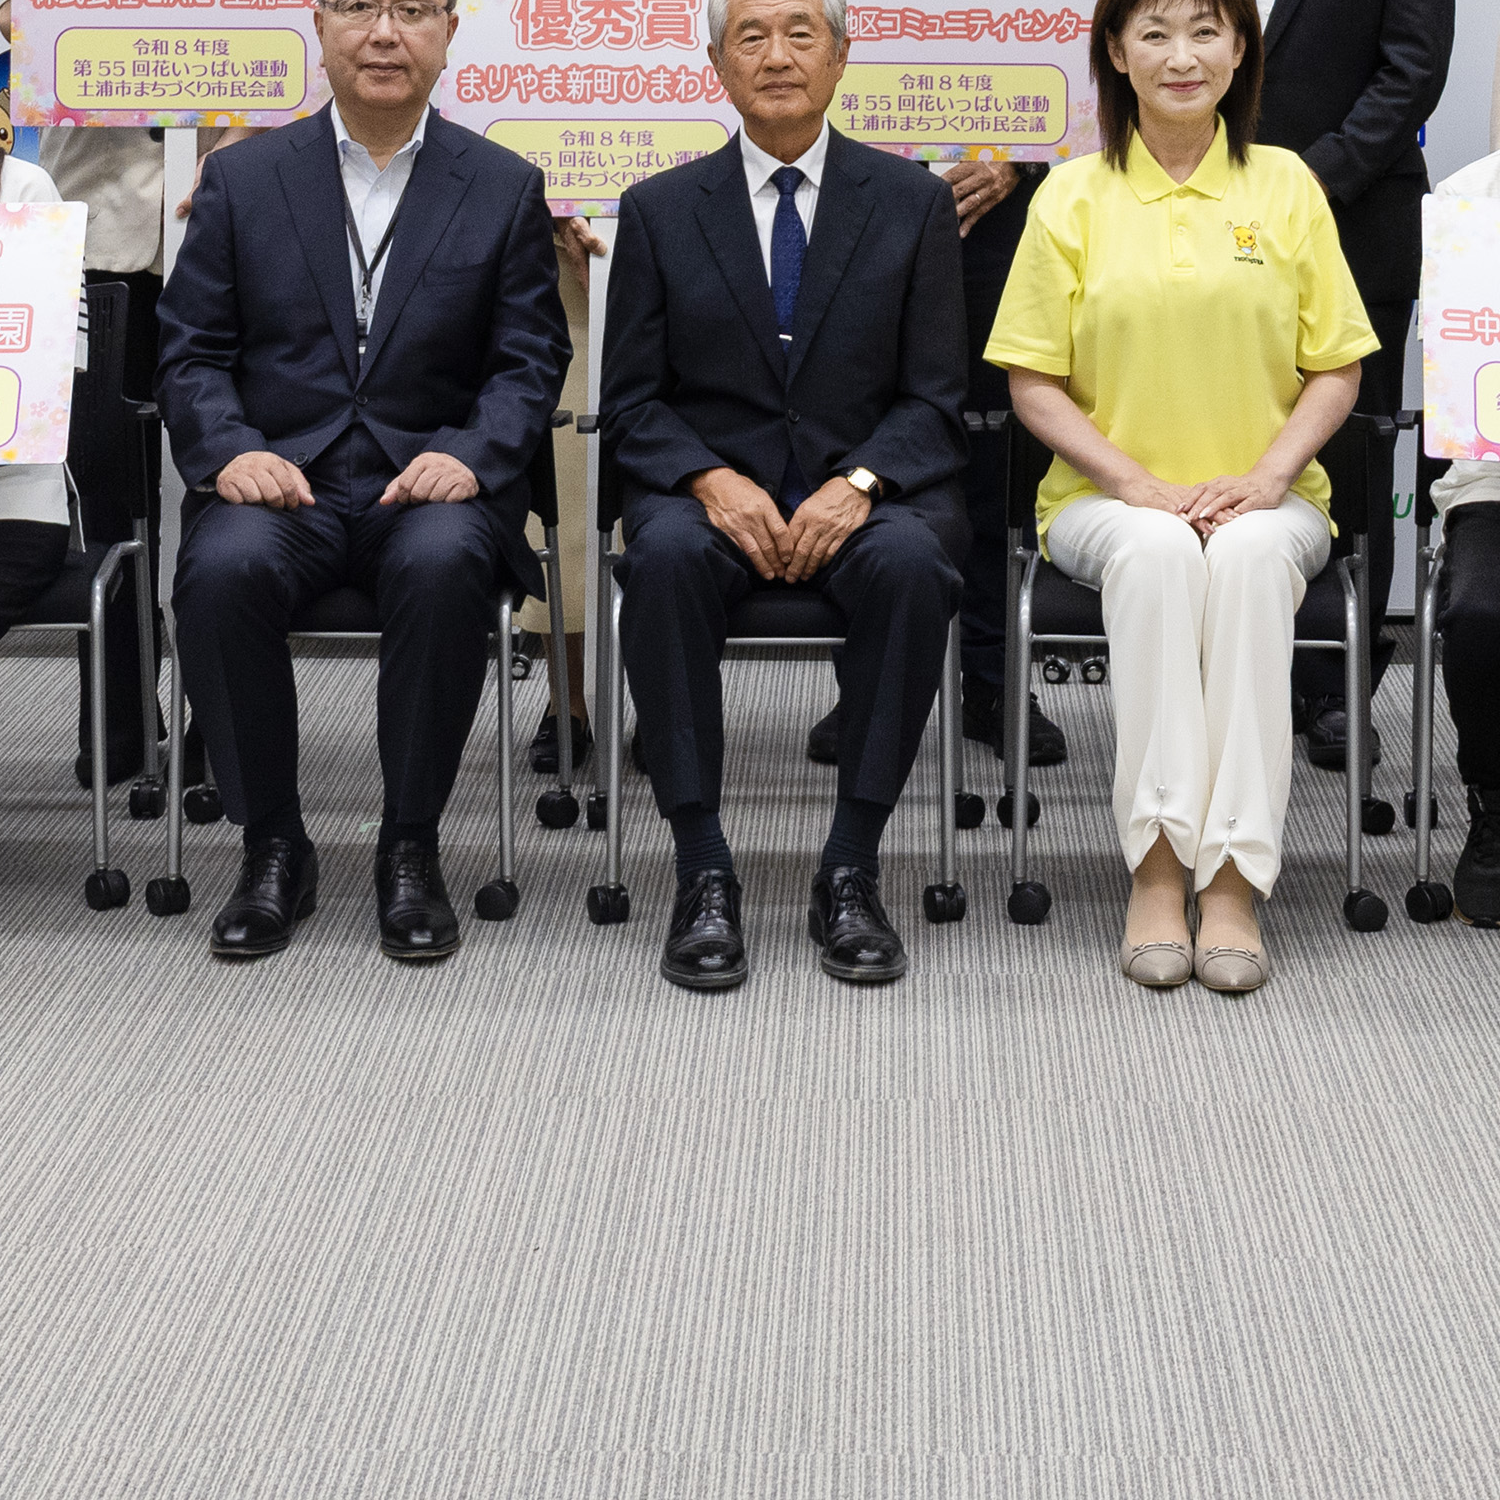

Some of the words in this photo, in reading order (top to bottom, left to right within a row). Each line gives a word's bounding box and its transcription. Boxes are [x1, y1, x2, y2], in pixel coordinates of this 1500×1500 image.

[76, 79, 286, 99] 土浦市まちづくり市民会議
[457, 64, 726, 103] まりやま新町ひまわり
[844, 115, 1047, 133] 土浦市まちづくり市民会議
